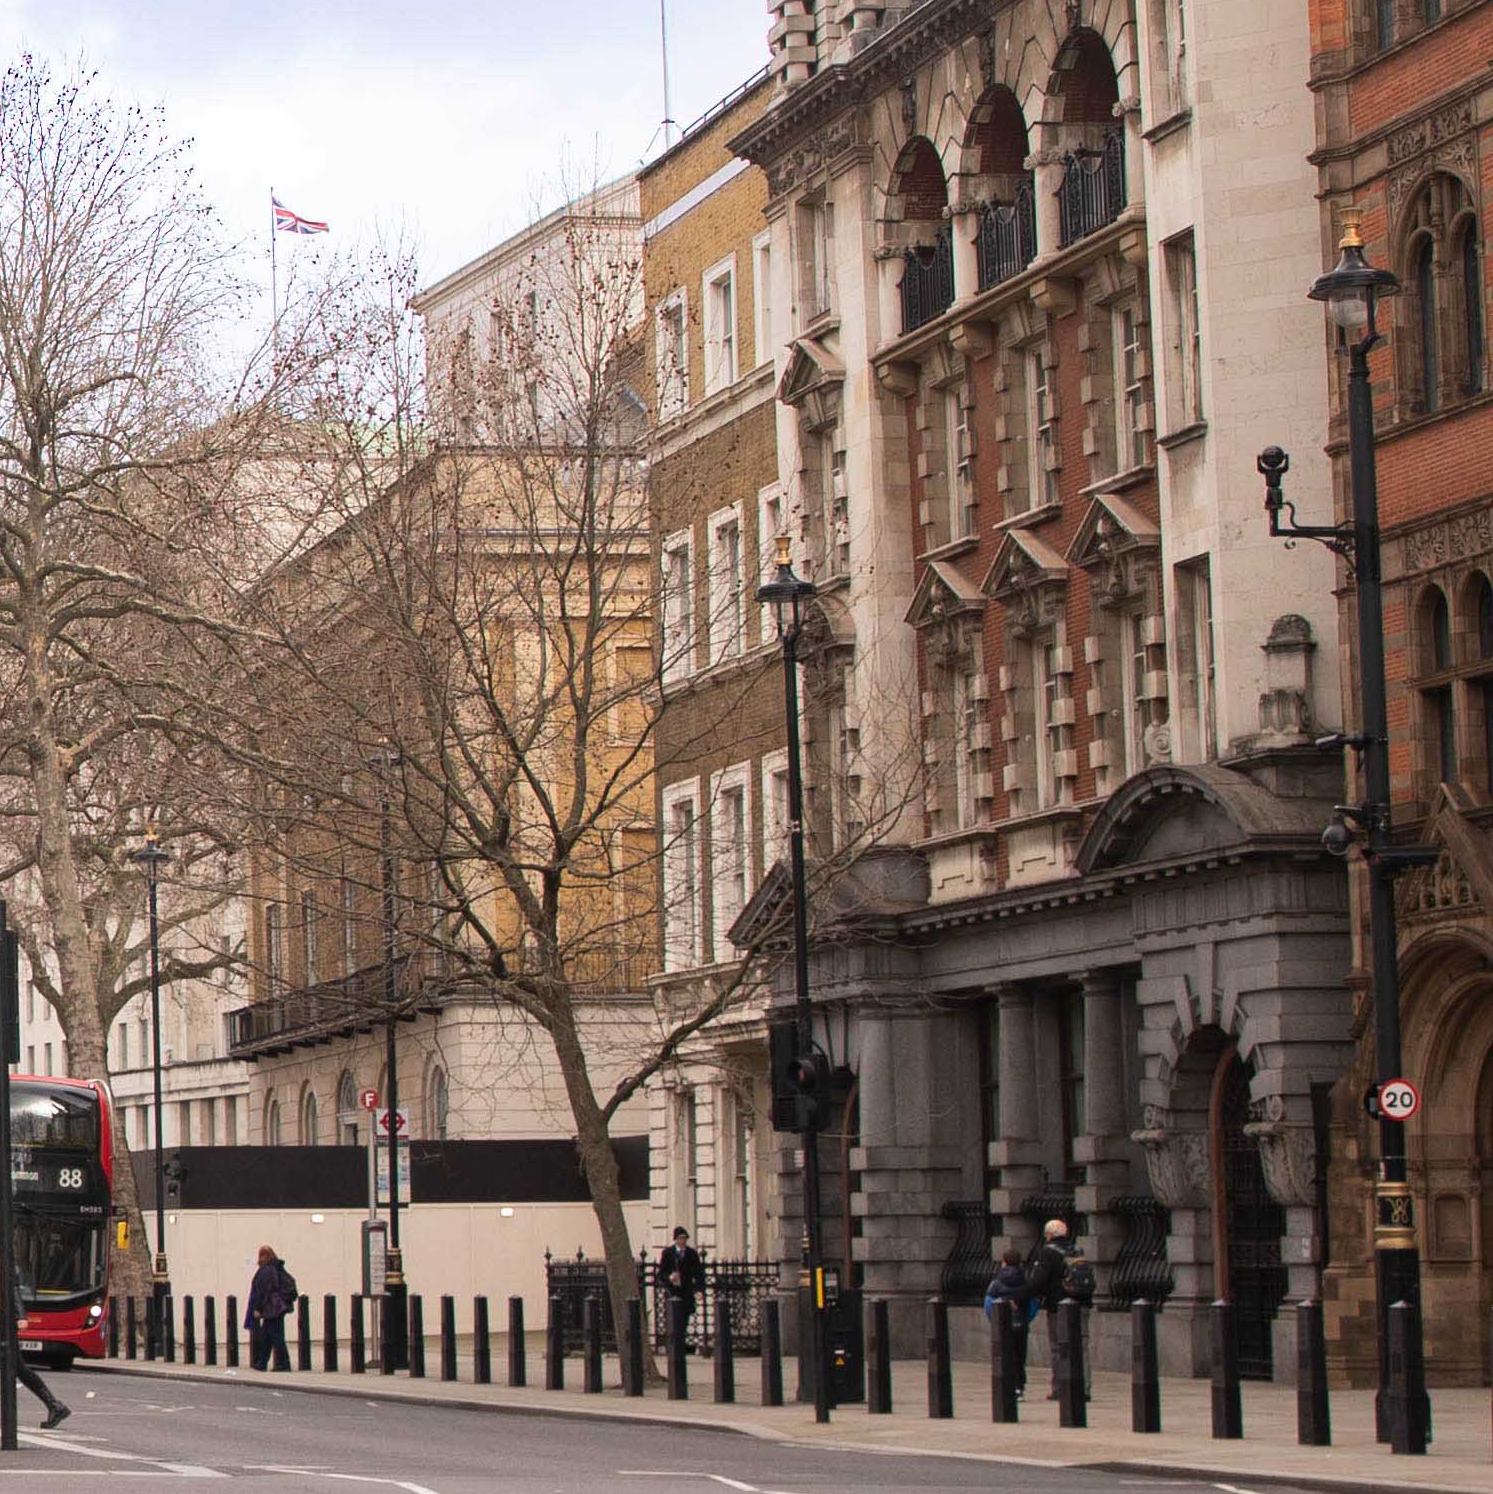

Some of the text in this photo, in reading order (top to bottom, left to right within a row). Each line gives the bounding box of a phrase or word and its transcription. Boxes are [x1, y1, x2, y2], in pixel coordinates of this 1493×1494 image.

[365, 1092, 374, 1107] F
[1385, 1091, 1413, 1108] 20
[59, 1168, 82, 1188] 88
